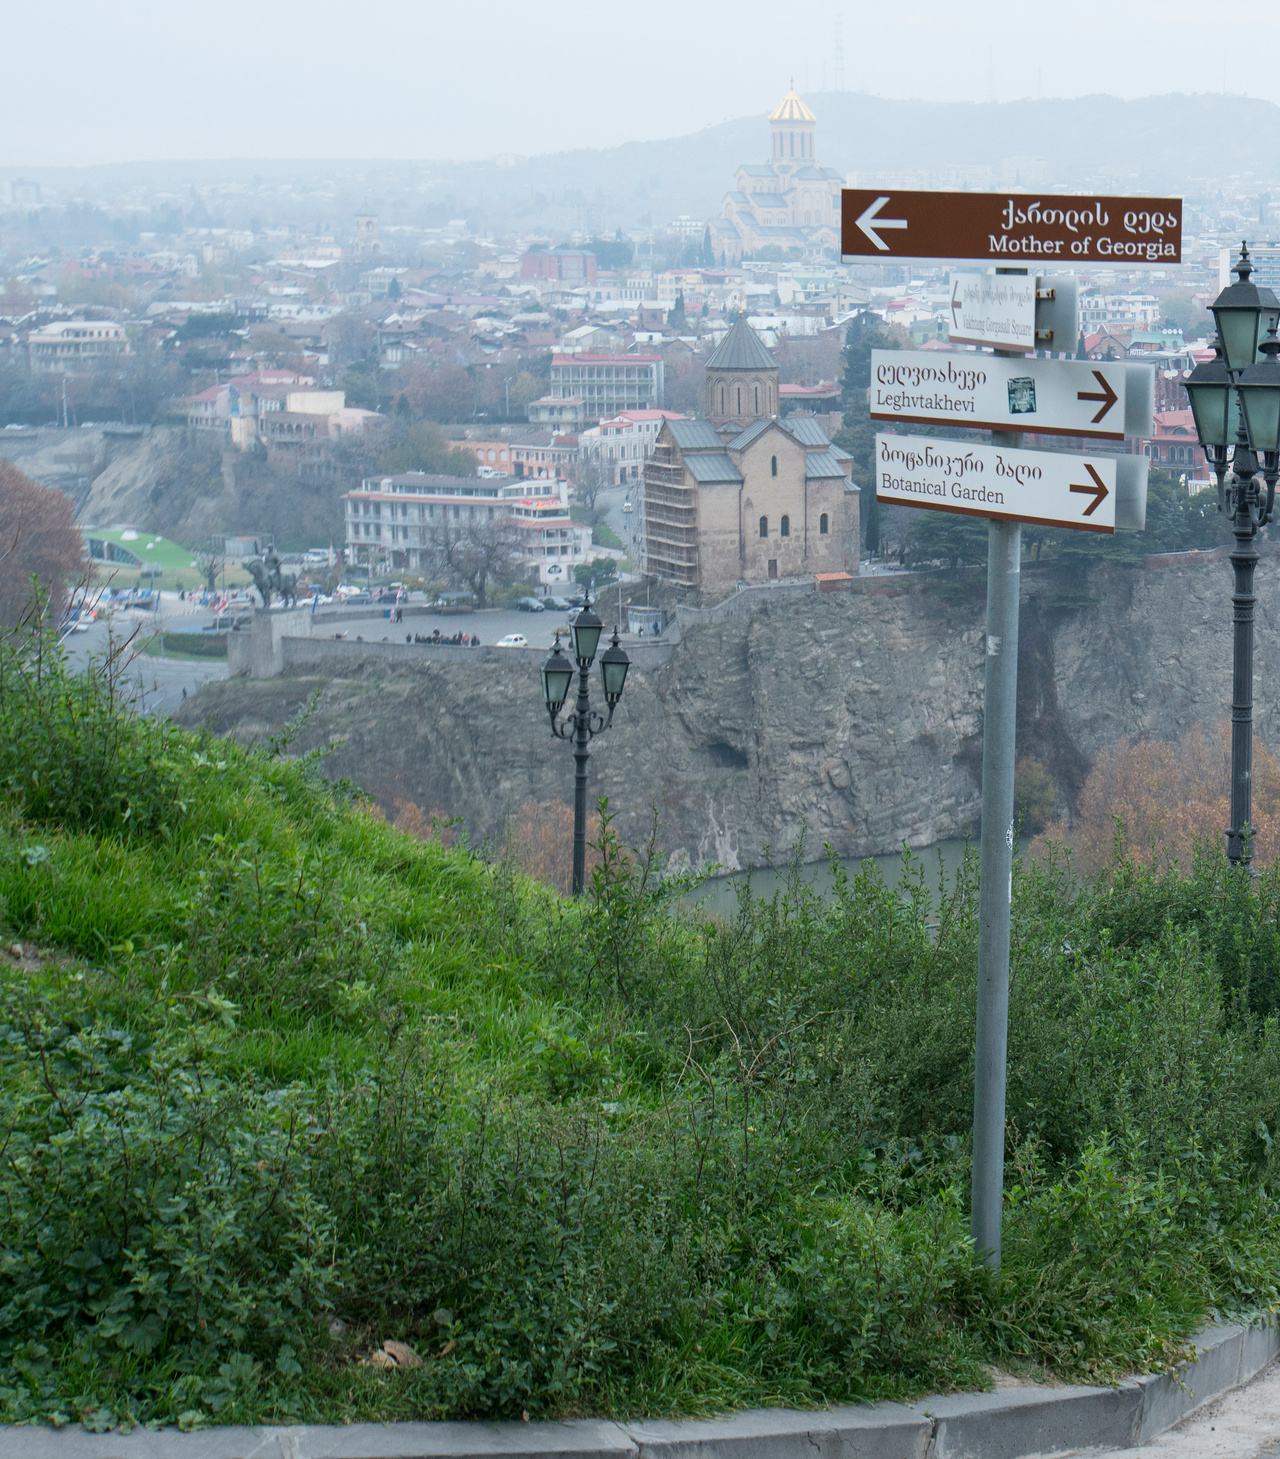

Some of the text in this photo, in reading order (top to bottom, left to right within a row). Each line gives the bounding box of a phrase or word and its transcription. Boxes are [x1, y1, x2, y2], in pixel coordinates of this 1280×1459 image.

[1001, 199, 1178, 234] ქართლის დედა
[988, 234, 1177, 260] Mother of Georgia
[1011, 318, 1032, 340] Square
[1130, 348, 1145, 356] HOTEL
[876, 361, 987, 391] ლეღვთახევი
[876, 389, 976, 412] Leghvtakhevi
[881, 441, 1042, 486] ბოტანიკური ბაღი
[881, 472, 1005, 504] Botanical Garden
